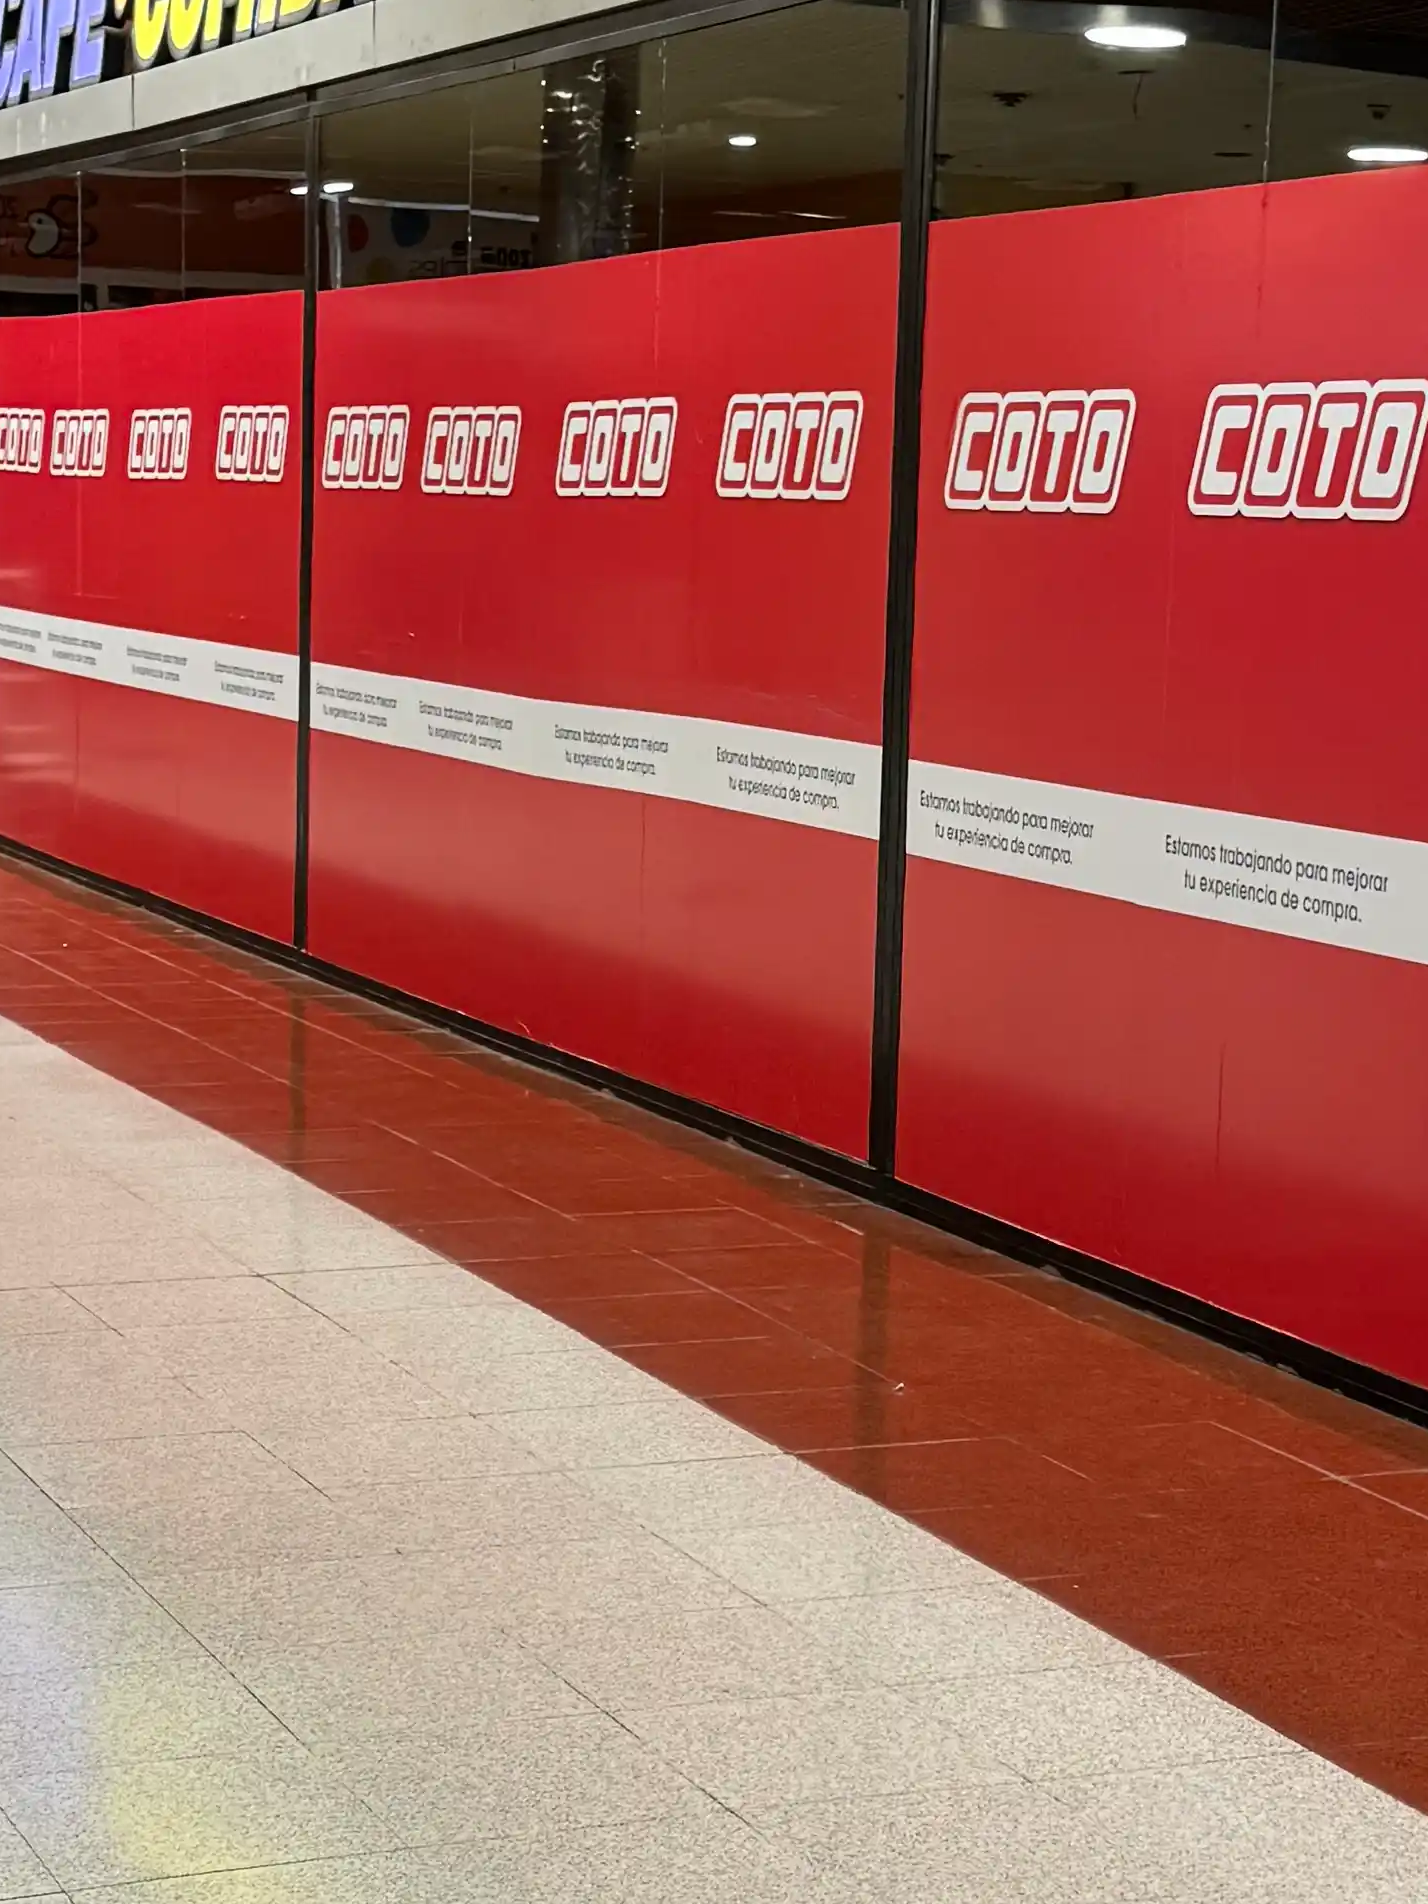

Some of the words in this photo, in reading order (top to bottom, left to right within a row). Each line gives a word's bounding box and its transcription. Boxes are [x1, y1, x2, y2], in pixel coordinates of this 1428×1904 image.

[50, 408, 110, 476] COTO
[128, 407, 192, 480] COTO
[216, 405, 289, 483] COTO
[322, 405, 410, 490] COTO
[420, 406, 522, 496] COTO
[555, 397, 677, 497] COTO
[716, 390, 864, 500] COTO
[944, 388, 1136, 514] COTO
[717, 746, 748, 767] Estamos
[751, 751, 796, 775] trabajando
[798, 762, 819, 781] para
[821, 766, 855, 788] mejorar
[729, 775, 737, 791] tu
[738, 778, 787, 799] experiencia
[789, 788, 801, 803] de
[920, 790, 960, 813] Estamos
[963, 797, 1019, 824] trabajando
[1022, 812, 1047, 830] para
[1050, 816, 1093, 839] mejorar
[935, 820, 944, 838] tu
[947, 825, 1008, 851] experiencia
[1011, 836, 1024, 854] de
[1028, 842, 1072, 865] compra.
[1165, 834, 1216, 862] Estamos
[1220, 844, 1292, 875] trabajando
[1296, 859, 1327, 882] para
[1333, 866, 1388, 893] mejorar
[1185, 869, 1195, 890] tu
[1200, 875, 1276, 905] experiencia
[1281, 889, 1298, 910] de
[1303, 896, 1362, 923] compra.
